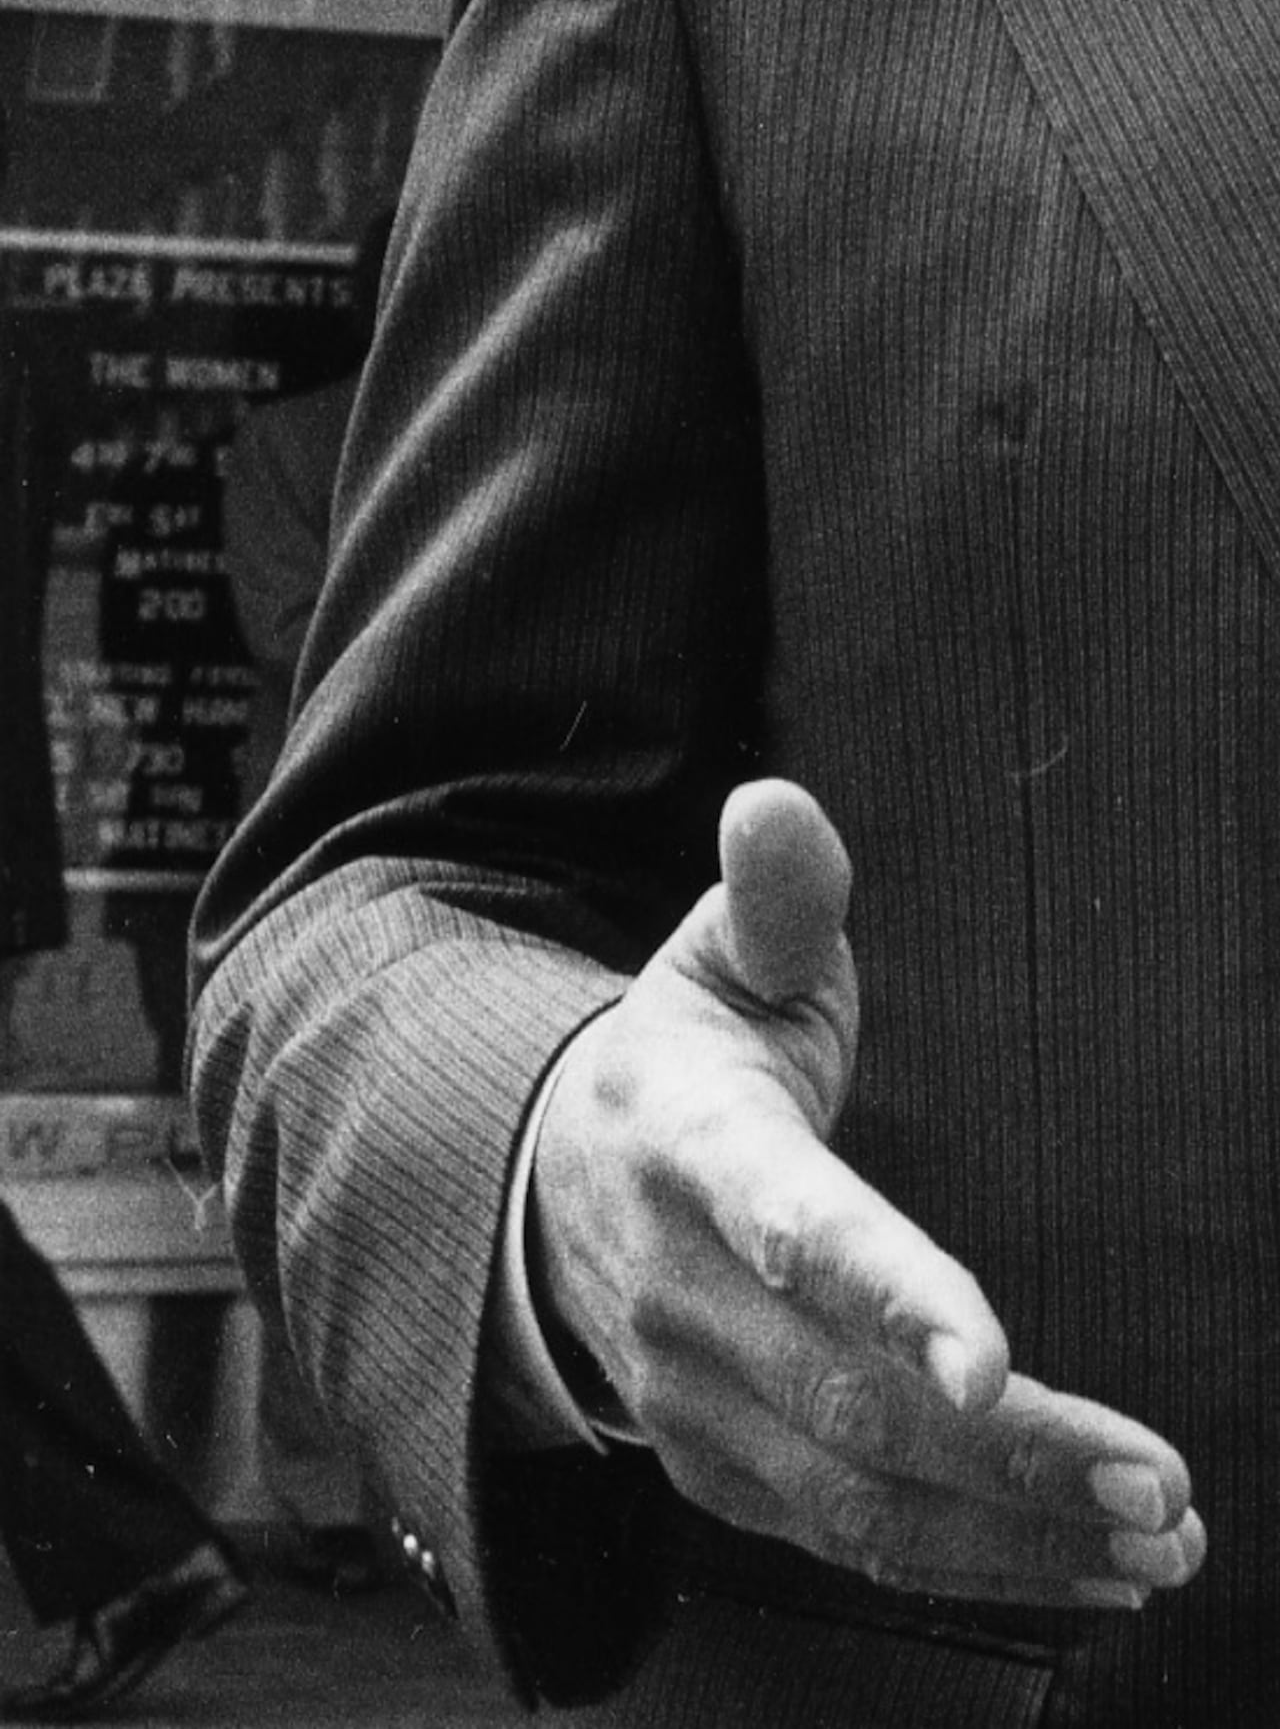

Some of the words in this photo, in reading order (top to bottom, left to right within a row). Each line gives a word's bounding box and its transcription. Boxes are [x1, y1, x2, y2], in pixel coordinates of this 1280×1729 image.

[43, 263, 152, 300] PLAZA
[171, 268, 351, 306] PRESENTS
[89, 351, 151, 389] THE
